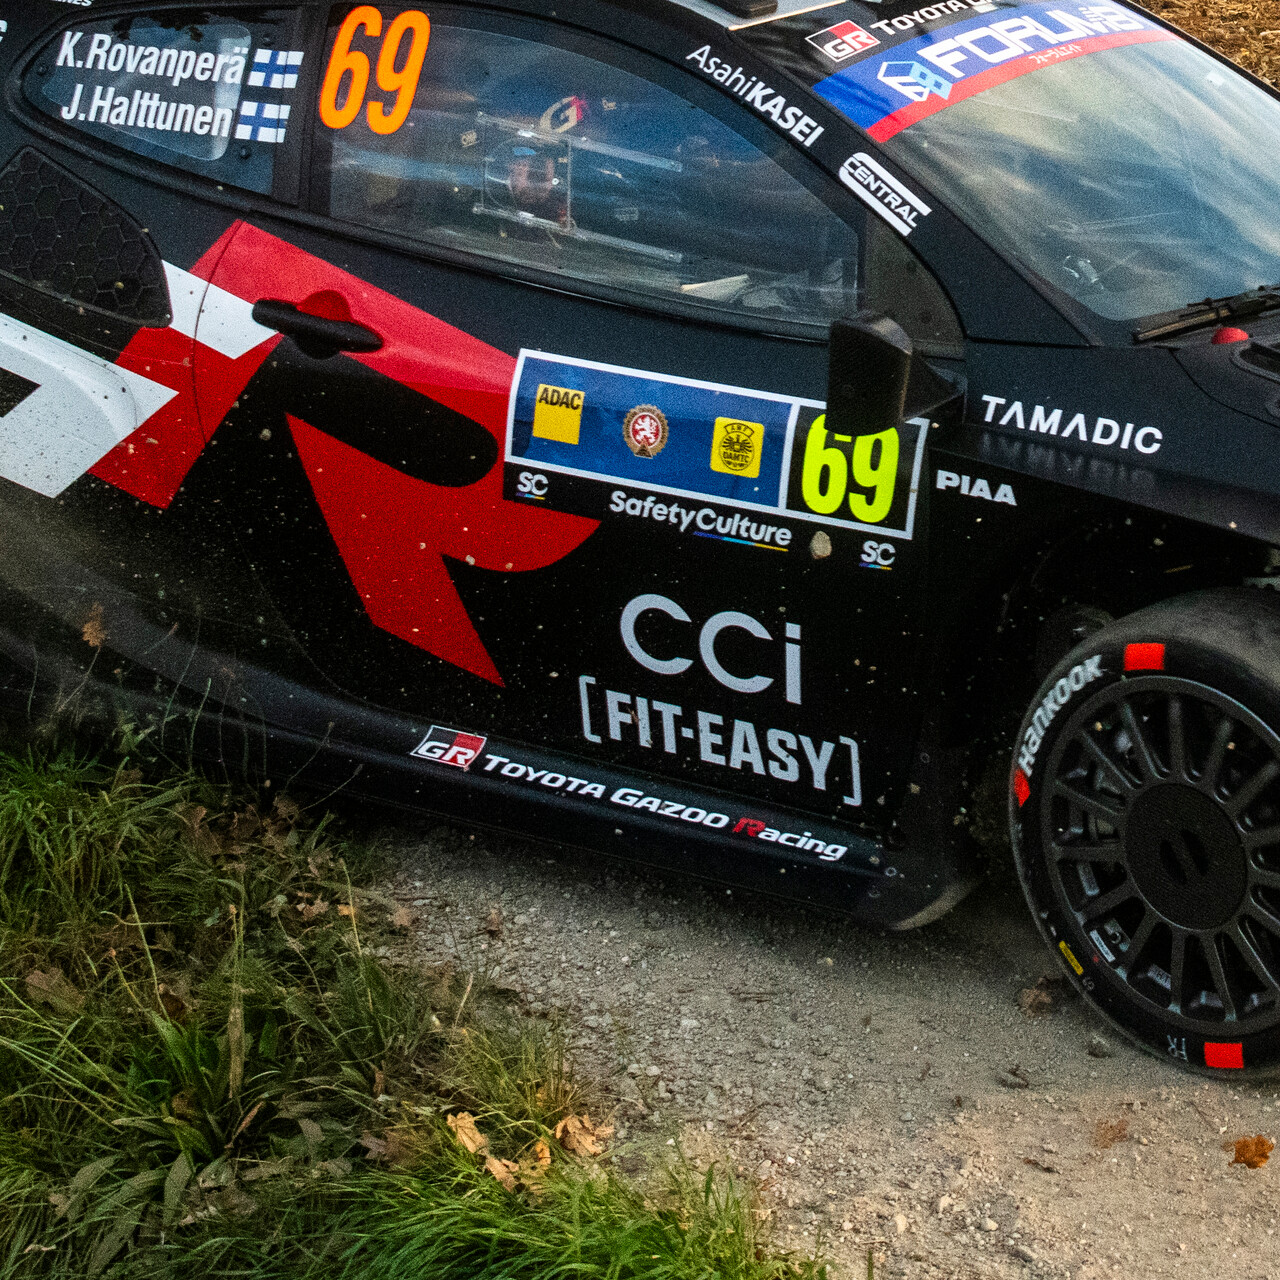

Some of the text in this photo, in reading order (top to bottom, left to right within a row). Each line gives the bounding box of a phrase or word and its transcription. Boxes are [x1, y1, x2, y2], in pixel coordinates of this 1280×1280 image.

[869, 0, 966, 36] TOYOTA
[56, 31, 248, 86] K.Rovanperä
[320, 6, 431, 135] 69
[62, 84, 234, 137] J.Halttunen
[841, 154, 919, 229] CENTRAL
[538, 387, 582, 410] ADAC
[981, 395, 1163, 454] TAMADIC
[516, 472, 548, 497] SC
[801, 413, 900, 523] 69
[936, 470, 1017, 506] PIAA
[609, 491, 793, 547] SafetyCulture
[860, 540, 896, 567] SC
[416, 741, 849, 862] GR TOYOTA GAZOO Racing
